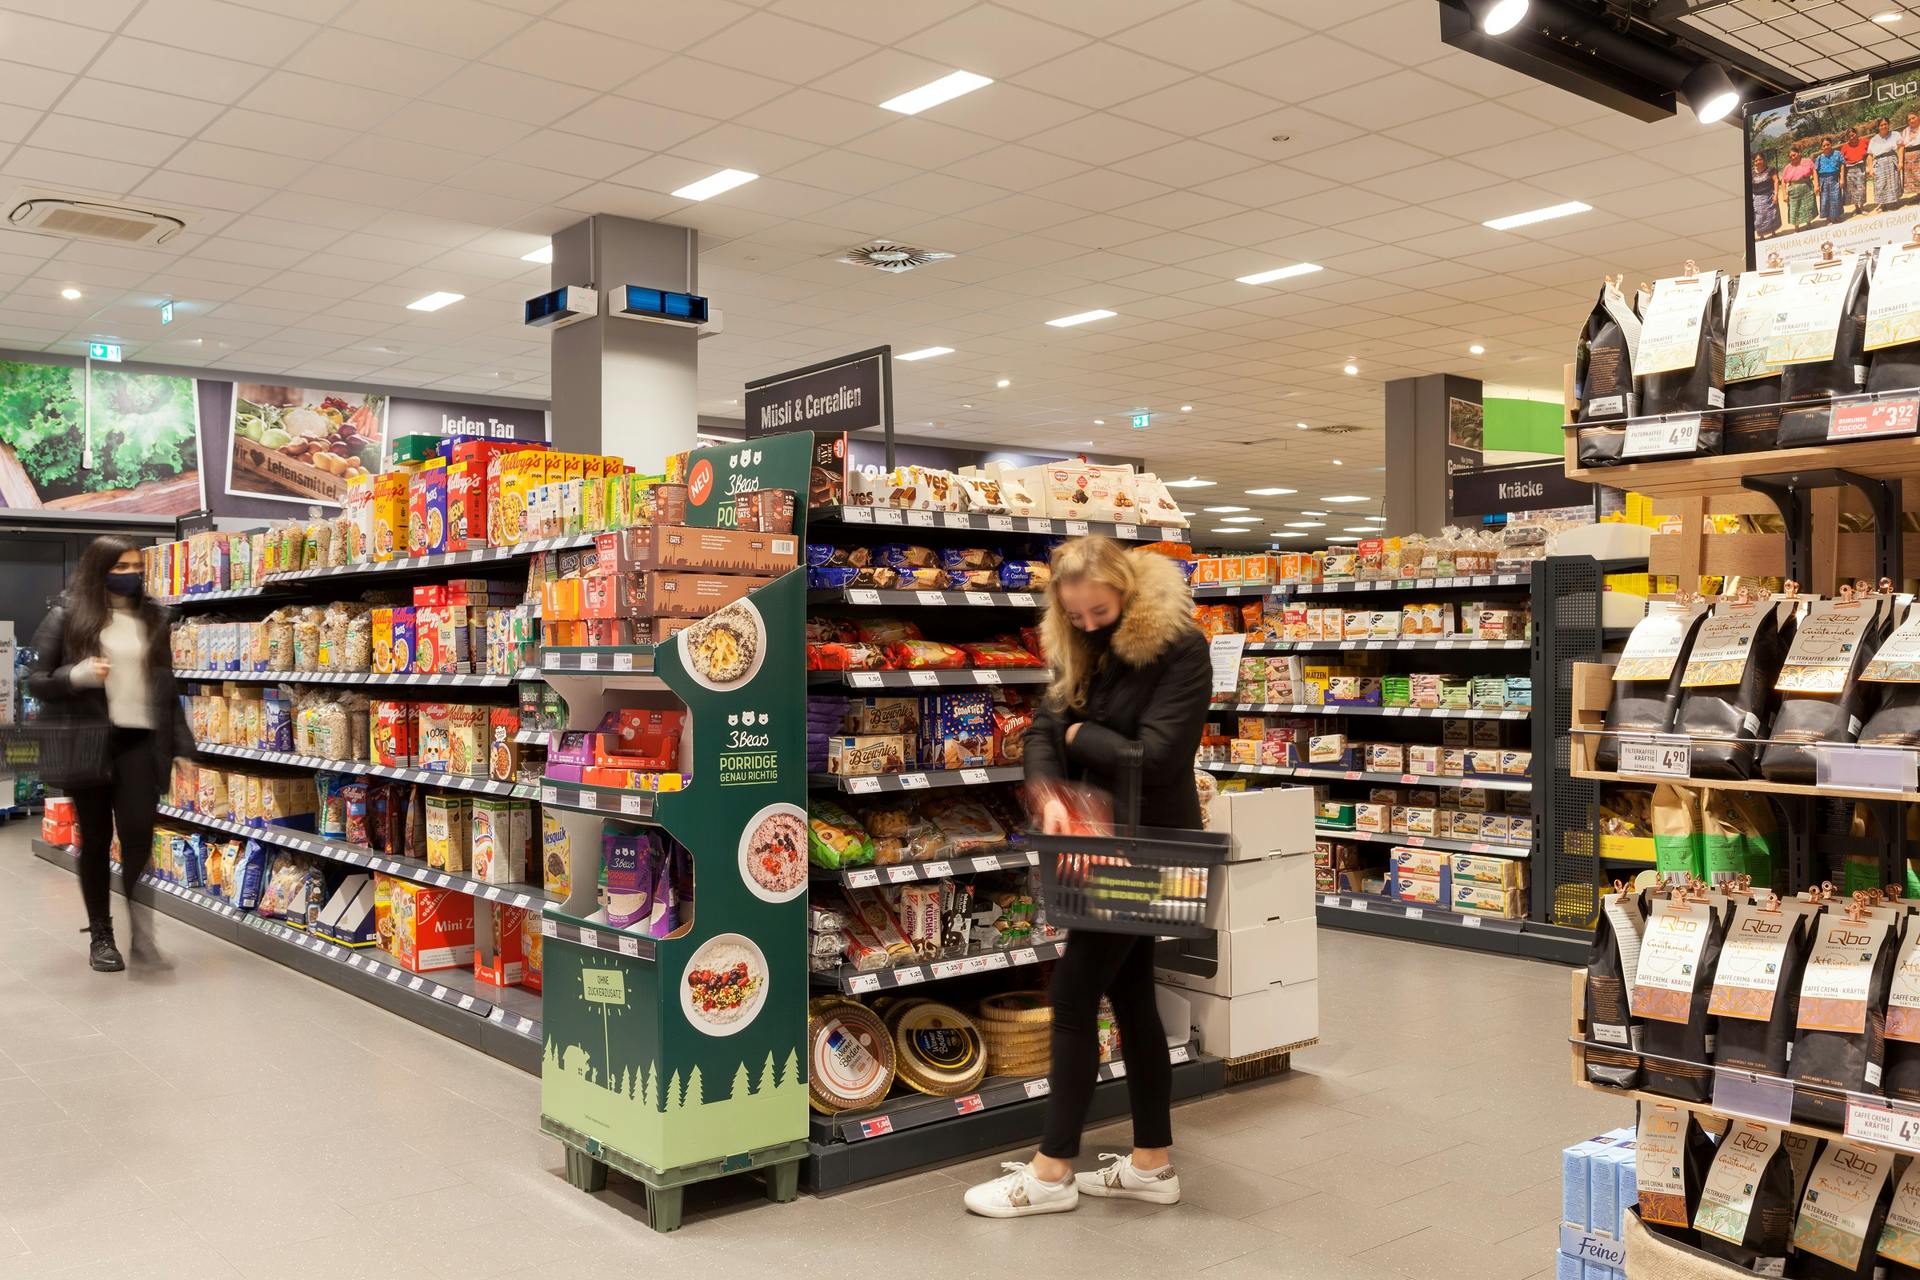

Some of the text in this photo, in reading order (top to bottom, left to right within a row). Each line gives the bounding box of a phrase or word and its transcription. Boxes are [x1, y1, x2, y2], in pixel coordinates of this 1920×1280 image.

[1877, 81, 1917, 101] Qbo
[1799, 272, 1843, 285] Qbo
[1728, 337, 1760, 348] FILTERKAFFEE
[761, 386, 862, 429] Müsli & Cerealien
[441, 414, 485, 438] Jeden
[1838, 423, 1868, 432] COCOCA
[447, 473, 482, 495] Kellogg's
[690, 467, 710, 498] NEU
[923, 473, 949, 491] yes
[1499, 480, 1544, 499] Knäcke
[1306, 671, 1327, 680] MATZEN
[449, 704, 485, 728] Kellogg's
[870, 706, 914, 725] Brownies
[726, 730, 769, 749] 3Bears
[849, 743, 898, 765] Brownies
[1625, 747, 1655, 755] FILTERKAFFEE
[720, 754, 778, 771] PORRIDGE
[720, 769, 778, 782] GENAU RICHTIG
[544, 826, 567, 846] Nesquik
[611, 857, 636, 869] 3Bears
[434, 921, 463, 934] Mini
[906, 904, 914, 936] KUCHEN
[925, 903, 934, 940] KUCHEN
[1660, 915, 1697, 932] Qbo
[1741, 918, 1782, 934] Qbo
[1828, 930, 1872, 946] Qbo
[597, 975, 609, 985] OHNE
[1653, 975, 1692, 987] CREMA KRÄFTIG
[1753, 977, 1776, 986] KRÄFTIG
[587, 986, 622, 999] ZUCKERZUSATZ
[1842, 986, 1866, 995] KRÄFTIG
[834, 1039, 853, 1059] Wiener
[839, 1045, 862, 1068] Boden
[1864, 1120, 1890, 1131] KRÄFTIG
[1871, 1114, 1890, 1123] CREMA
[1639, 1142, 1679, 1154] Guatemala
[1733, 1131, 1769, 1153] Qbo
[1718, 1154, 1757, 1173] Guatemala
[1833, 1148, 1878, 1175] Qbo
[1665, 1181, 1683, 1191] KRÄFTIG
[1704, 1187, 1731, 1201] FILTERKAFFEE
[1803, 1202, 1856, 1229] FILTERKAFFEE MILD
[1578, 1236, 1619, 1262] Feine
